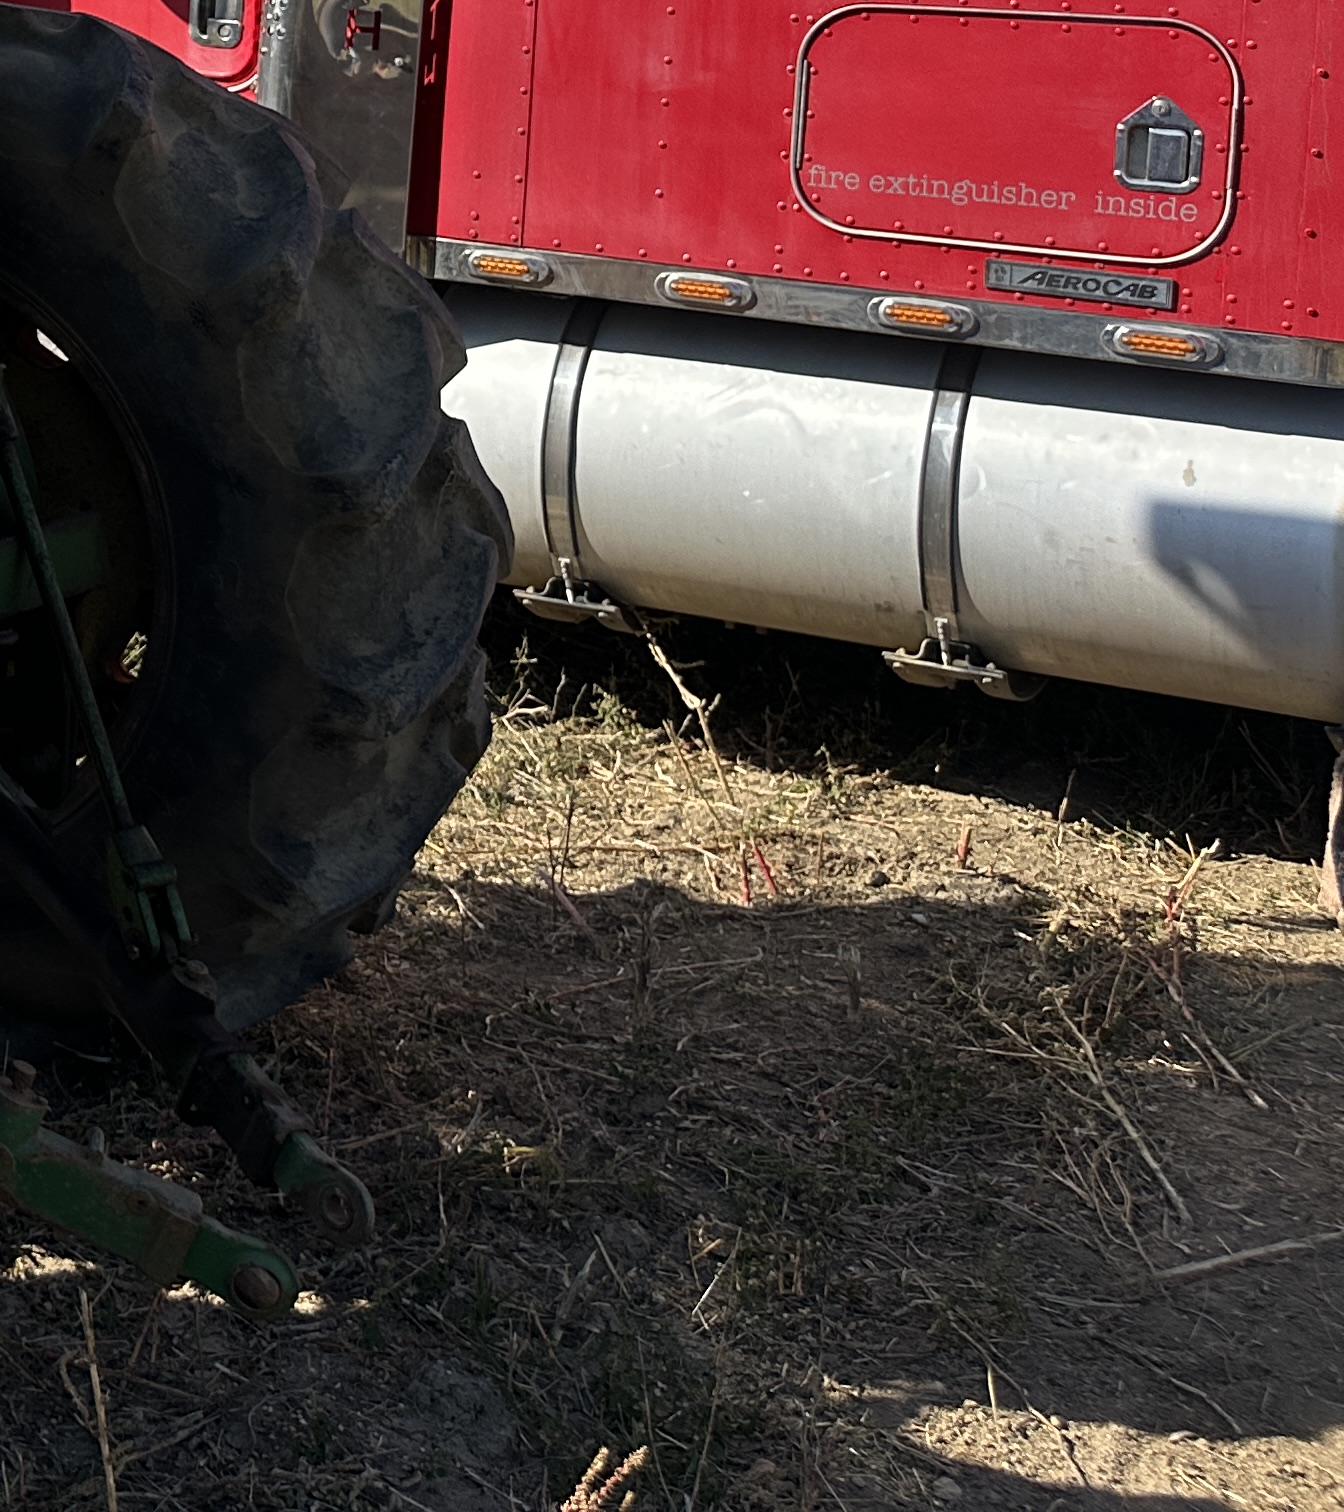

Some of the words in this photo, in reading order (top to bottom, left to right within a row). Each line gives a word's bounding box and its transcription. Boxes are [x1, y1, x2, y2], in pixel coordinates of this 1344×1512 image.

[807, 164, 860, 190] fire
[869, 173, 1075, 212] extinguisher
[1093, 190, 1198, 223] inside
[1017, 270, 1159, 299] AEROCAB
